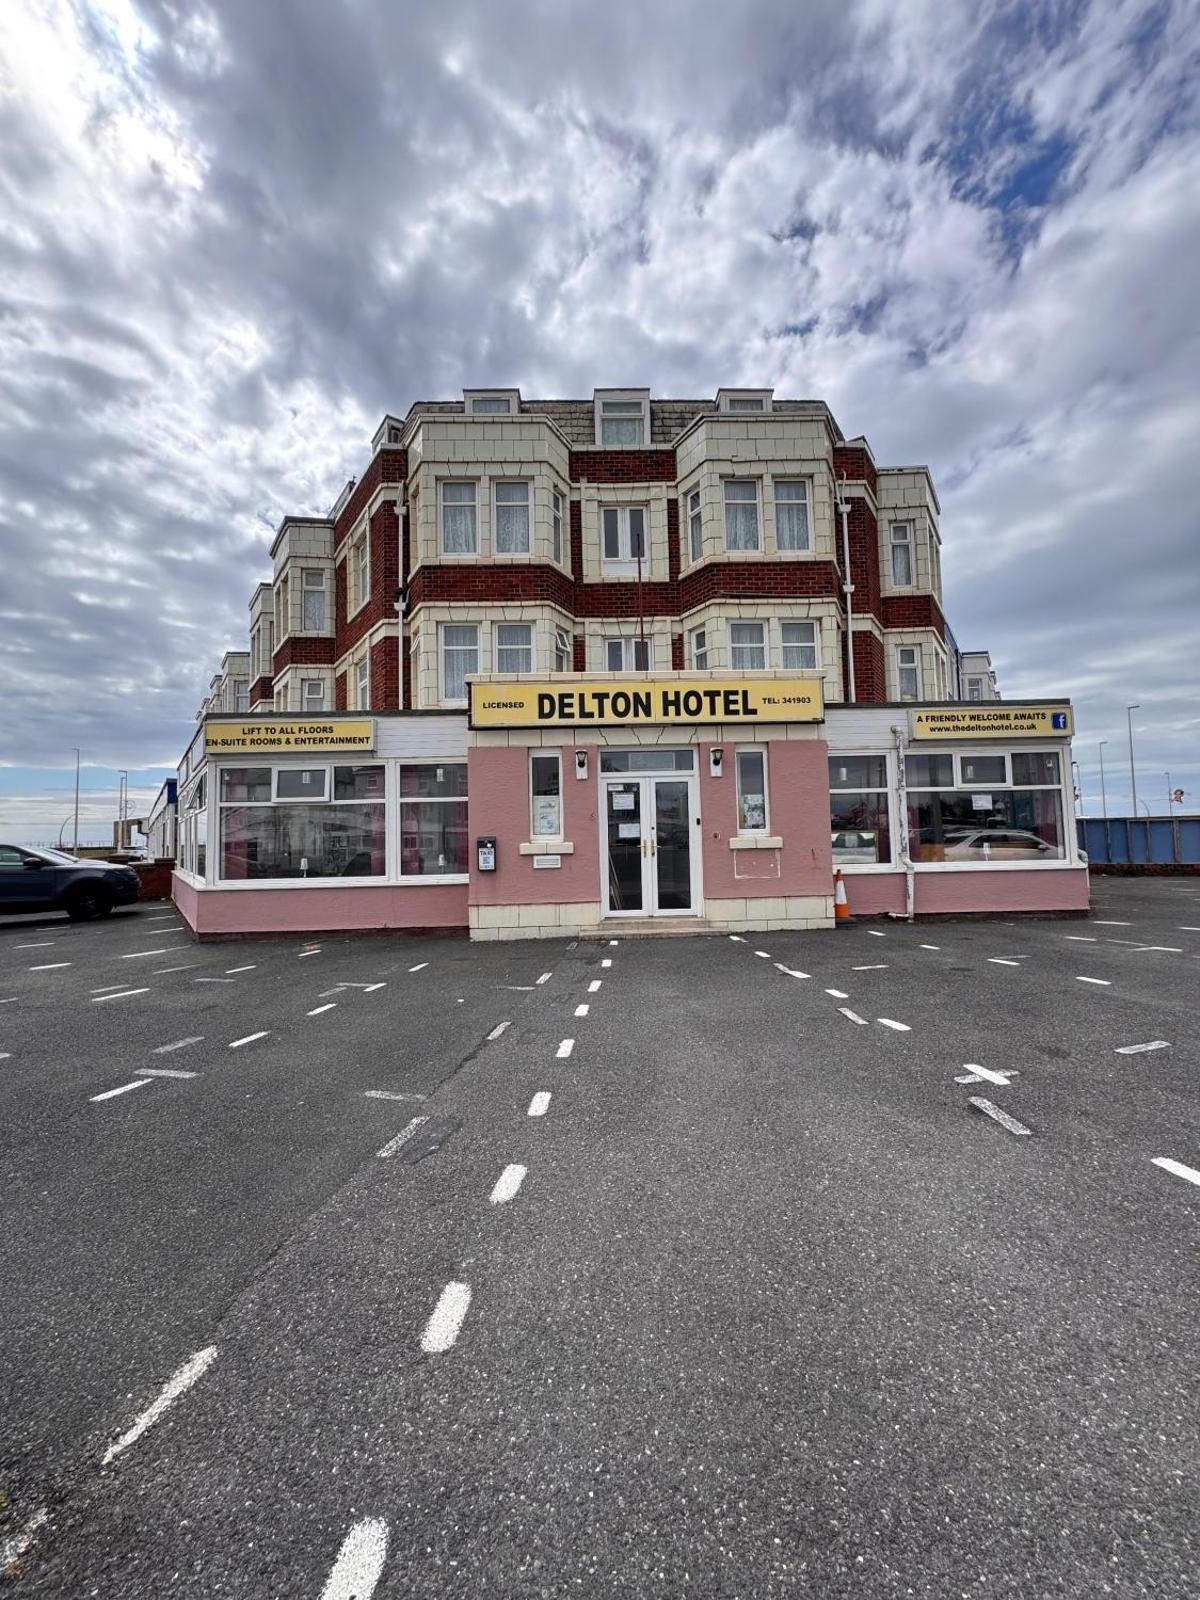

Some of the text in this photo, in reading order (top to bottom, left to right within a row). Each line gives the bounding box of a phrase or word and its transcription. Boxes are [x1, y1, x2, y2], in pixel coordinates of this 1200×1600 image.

[538, 689, 758, 719] DELTON HOTEL
[761, 696, 811, 705] TEL: 341903
[917, 712, 1046, 723] A FRIENDLY WELCOME AWAITS
[242, 725, 334, 735] LIFT TO ALL FLOORS
[929, 723, 1037, 733] www.thedeltonhotel.co.uk
[205, 736, 371, 747] EN-SUITE ROOMS & ENTERTAINMENT
